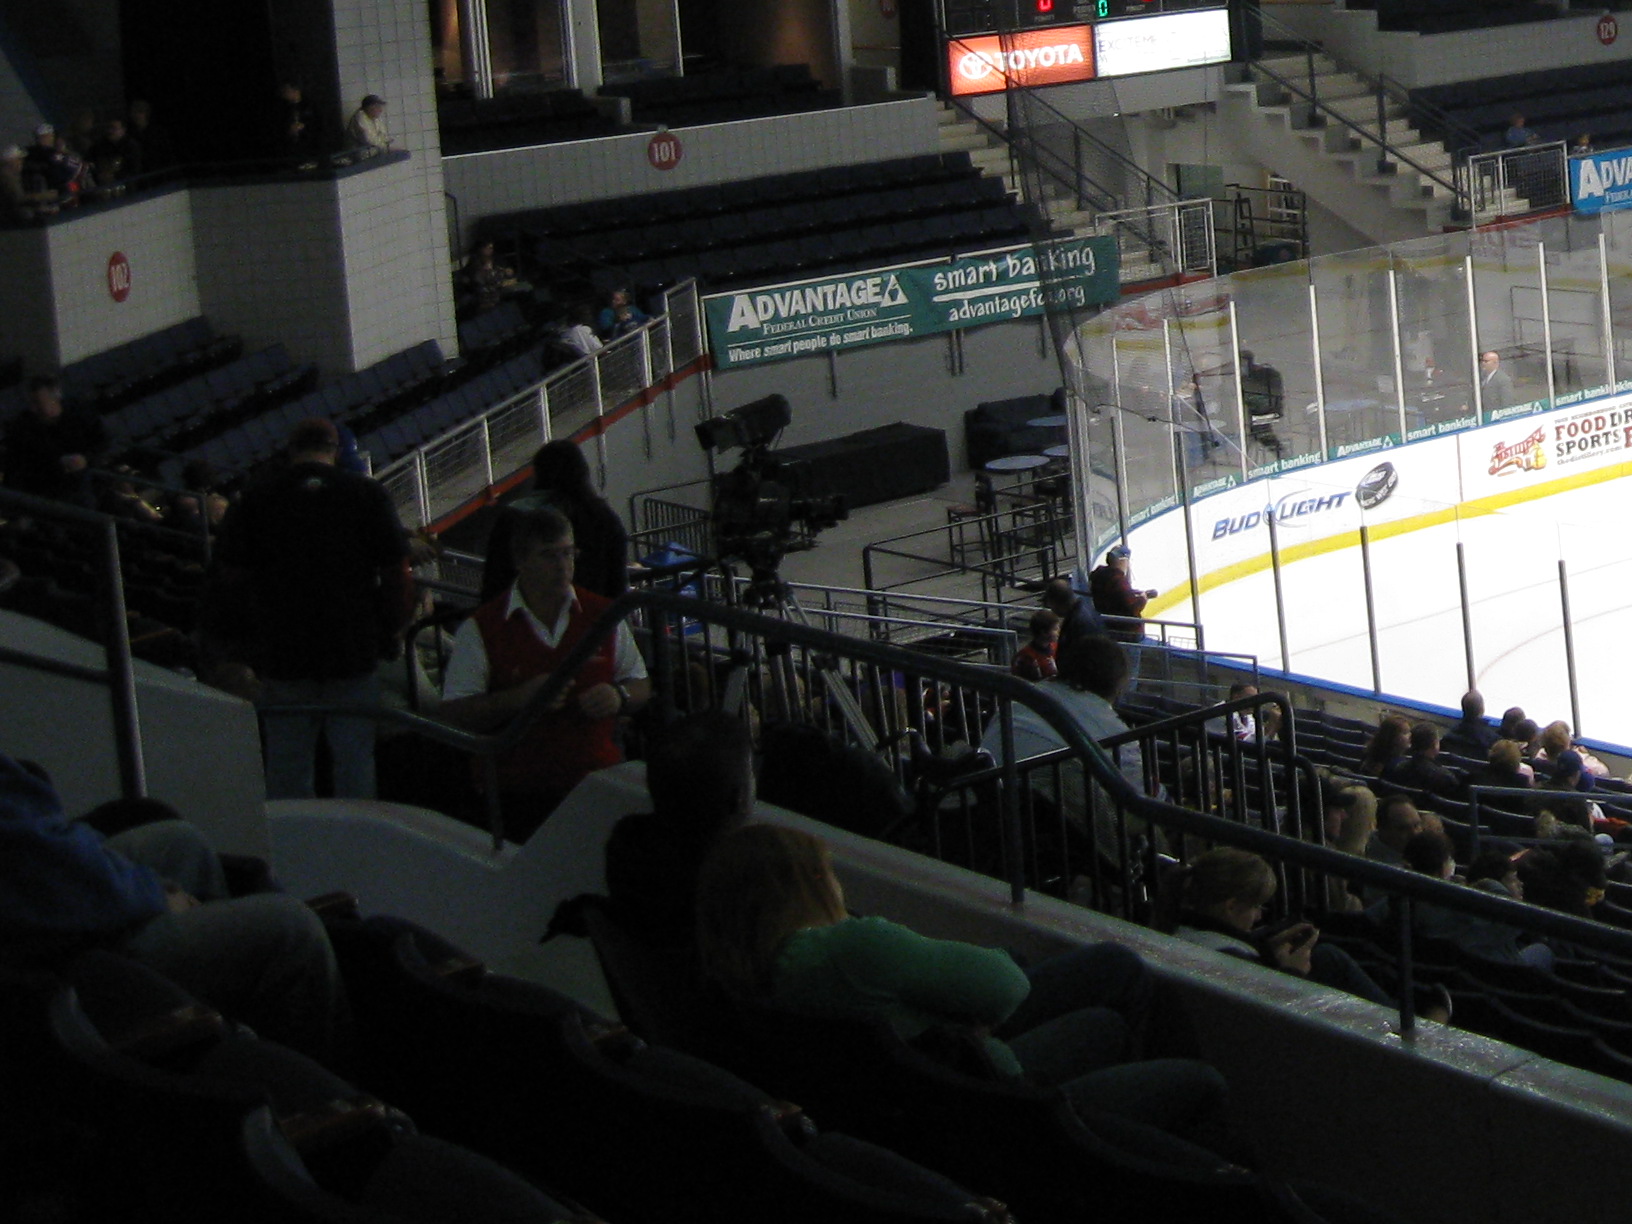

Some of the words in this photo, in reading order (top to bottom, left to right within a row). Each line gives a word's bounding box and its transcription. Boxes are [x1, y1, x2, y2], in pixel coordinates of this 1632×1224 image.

[994, 44, 1083, 71] TOYOTA
[652, 140, 675, 163] 101
[934, 261, 998, 291] smart
[727, 277, 883, 332] ADVANTAGE
[763, 320, 806, 335] FEDERAL
[808, 313, 844, 327] CREDIT
[847, 308, 878, 321] UNION
[728, 347, 761, 363] Where
[764, 340, 792, 357] smart
[793, 334, 827, 353] people
[829, 333, 841, 346] do
[843, 327, 870, 343] smart
[1555, 392, 1582, 406] smart
[1408, 426, 1436, 441] smart
[1438, 417, 1477, 434] banking
[1555, 416, 1606, 440] FOOD
[1556, 429, 1621, 457] SPORTS
[1248, 462, 1278, 478] smart
[1281, 451, 1322, 470] banking
[1212, 511, 1261, 541] BUD
[1279, 492, 1352, 520] LIGHT
